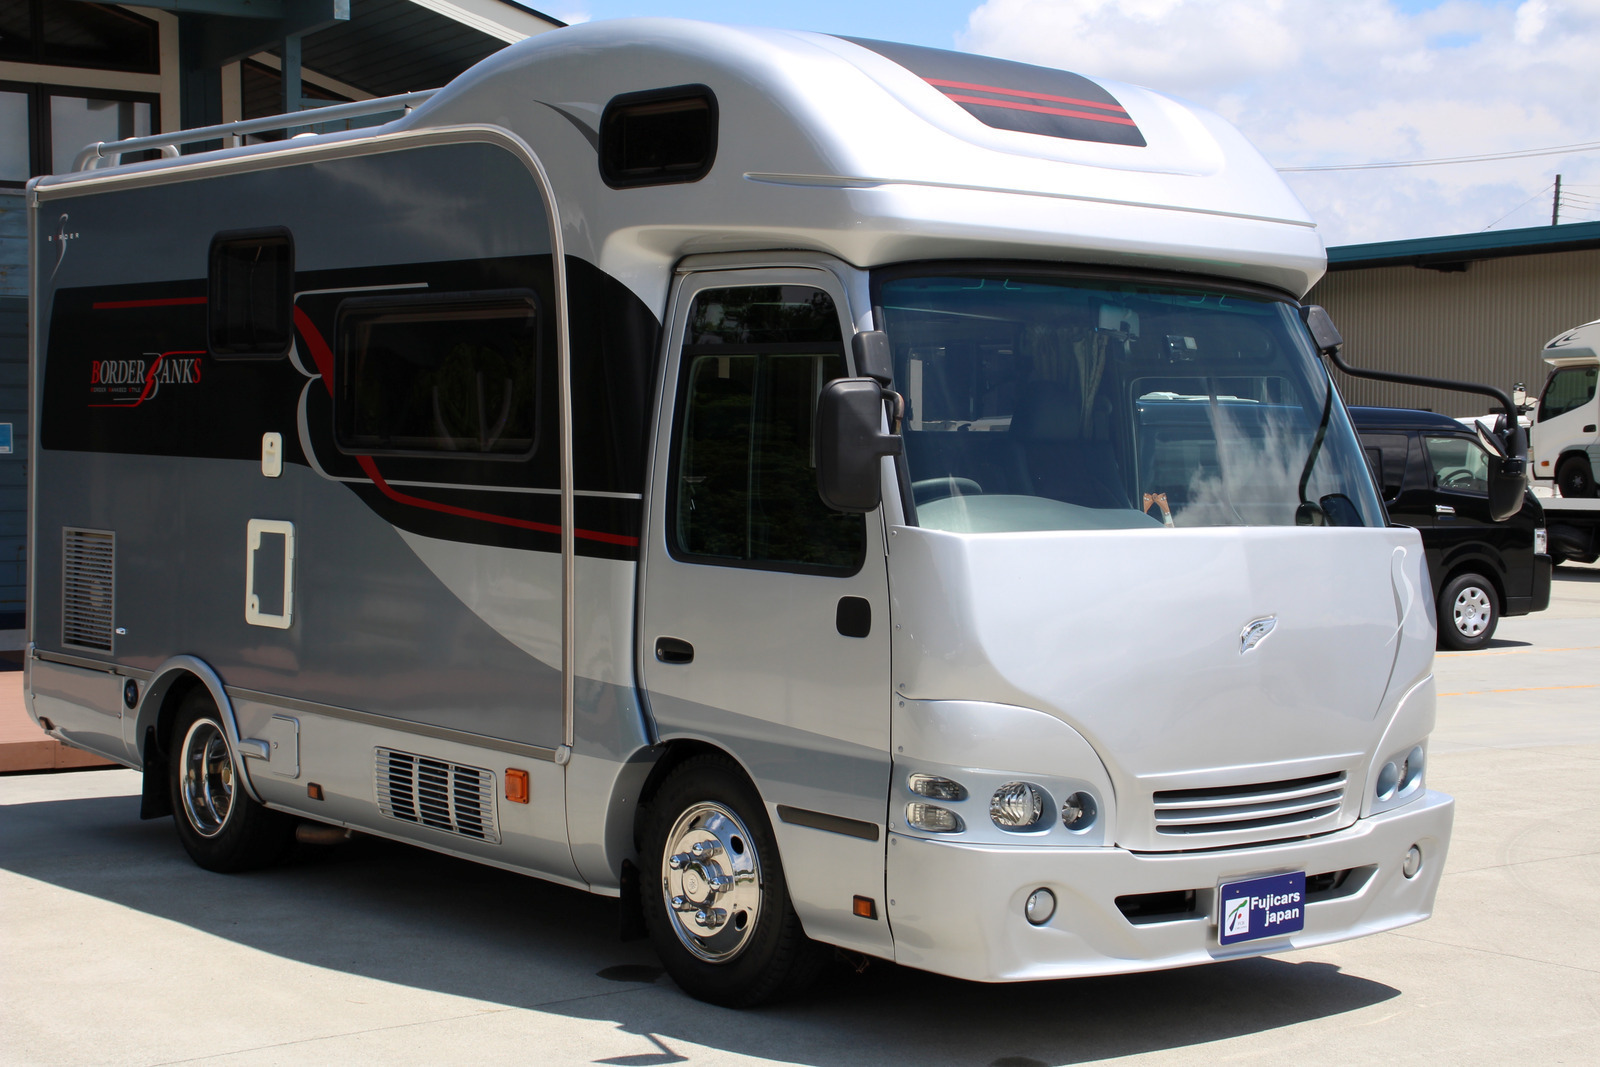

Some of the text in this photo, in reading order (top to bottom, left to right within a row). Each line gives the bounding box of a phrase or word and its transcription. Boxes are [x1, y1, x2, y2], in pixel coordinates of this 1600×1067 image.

[91, 360, 145, 384] BORDER
[1251, 892, 1300, 911] Fujicars
[1264, 908, 1299, 927] japan
